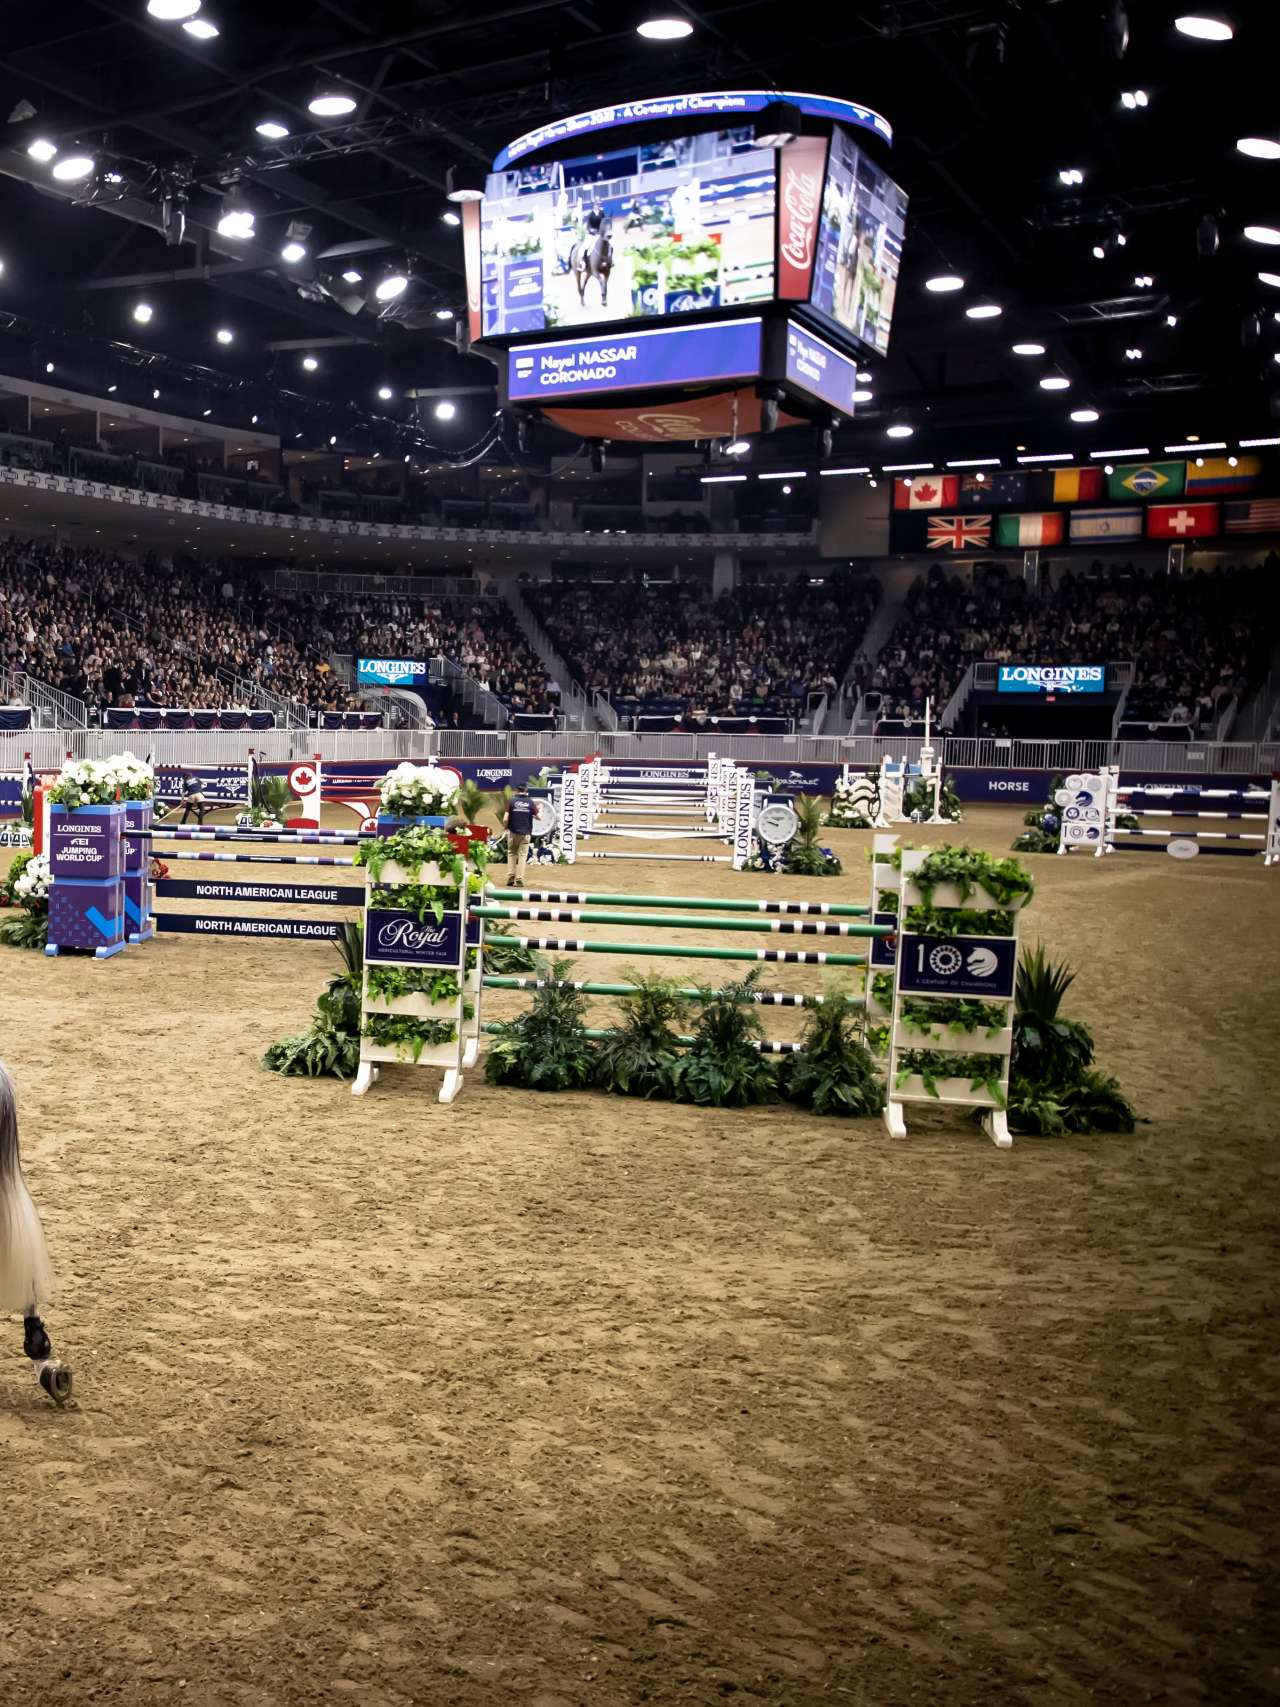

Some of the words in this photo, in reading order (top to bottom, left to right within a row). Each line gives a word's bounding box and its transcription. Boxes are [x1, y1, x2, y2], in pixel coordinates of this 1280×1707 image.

[624, 105, 634, 117] A
[633, 102, 675, 115] Century
[675, 97, 688, 111] of
[688, 96, 746, 110] Champions
[541, 354, 575, 371] Nayel
[578, 346, 637, 365] NASSAR
[540, 366, 617, 385] CORONADO
[359, 660, 426, 674] LONGINES
[1002, 667, 1102, 681] LONGINES
[477, 768, 513, 777] LONGINES
[988, 781, 1030, 792] HORSE
[563, 779, 575, 852] LONGINES
[736, 783, 752, 858] LONGINES
[57, 825, 102, 834] LONGINES
[56, 854, 85, 862] WORLD
[61, 847, 98, 856] JUMPING
[196, 884, 232, 896] NORTH
[235, 887, 293, 899] AMERICAN
[295, 890, 338, 900] LEAGUE
[195, 919, 232, 931] NORTH
[234, 922, 292, 934] AMERICAN
[294, 925, 337, 936] LEAGUE
[378, 918, 449, 949] Royal
